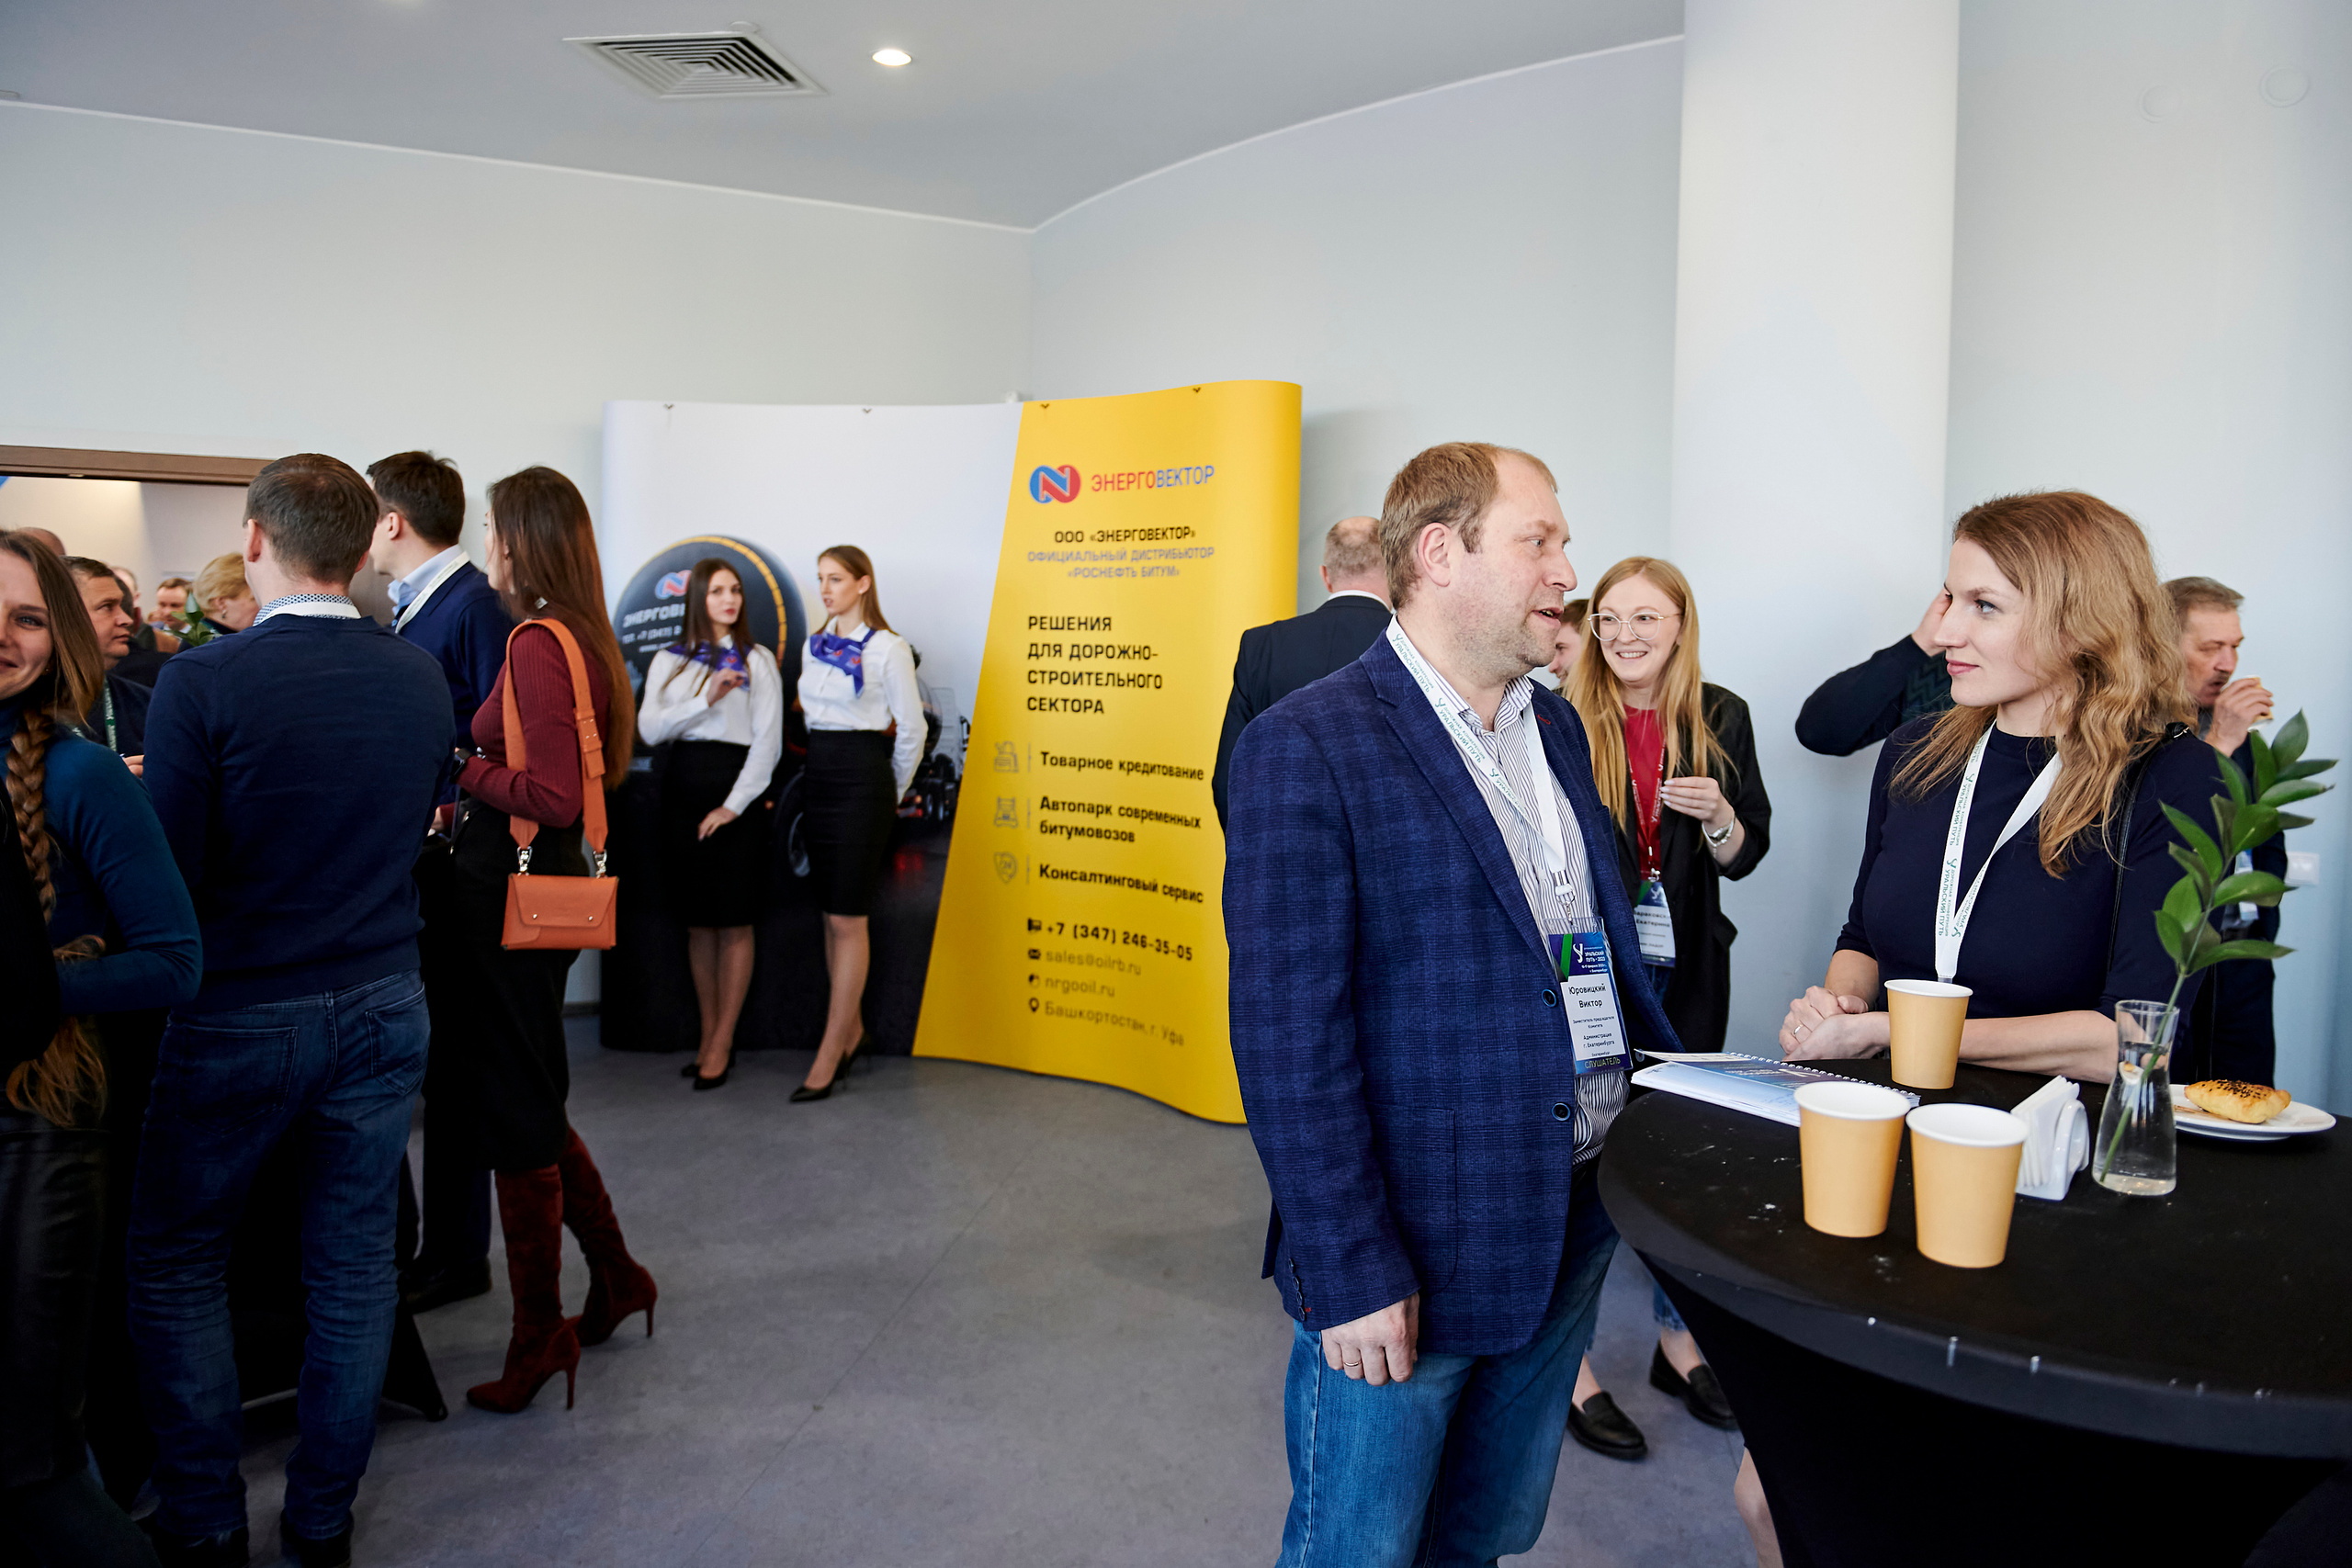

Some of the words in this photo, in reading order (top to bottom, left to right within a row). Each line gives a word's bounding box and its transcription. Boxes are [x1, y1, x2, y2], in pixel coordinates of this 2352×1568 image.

[1091, 465, 1215, 492] ЭНЕРГОВЕКТОР
[1055, 531, 1084, 543] ООО
[1090, 525, 1196, 543] «ЭНЕРГОВЕКТОР»
[1027, 548, 1127, 563] ОФИЦИАЛЬНЫЙ
[1131, 547, 1215, 562] ДИСТРИБЬЮТОР
[1028, 616, 1113, 632] РЕШЕНИЯ
[1027, 643, 1063, 660] ДЛЯ
[1069, 644, 1159, 661] ДОРОЖНО-
[1027, 670, 1163, 690] СТРОИТЕЛЬНОГО
[1027, 696, 1105, 715] СЕКТОРА
[1040, 750, 1114, 771] Товарное
[1118, 760, 1204, 781] кредитование
[1040, 795, 1114, 818] Автопарк
[1118, 805, 1202, 829] современных
[1040, 819, 1136, 842] битумовозов
[1039, 863, 1159, 894] Консалтинговый
[1161, 883, 1204, 904] сервис
[1939, 869, 1951, 914] УРАЛЬСКИЙ
[1938, 915, 1947, 936] ПУТЬ
[1047, 921, 1066, 936] +7
[1073, 924, 1117, 945] (347)
[1122, 931, 1193, 962] 246-35-05
[1046, 949, 1143, 976] sales@oilrb.ru
[1045, 977, 1116, 998] nrgooil.ru
[1568, 983, 1607, 996] Юровицкий
[1578, 999, 1603, 1009] Виктор
[1161, 1026, 1185, 1047] Уфа
[1584, 1056, 1622, 1069] СЛУШАТЕЛЬ
